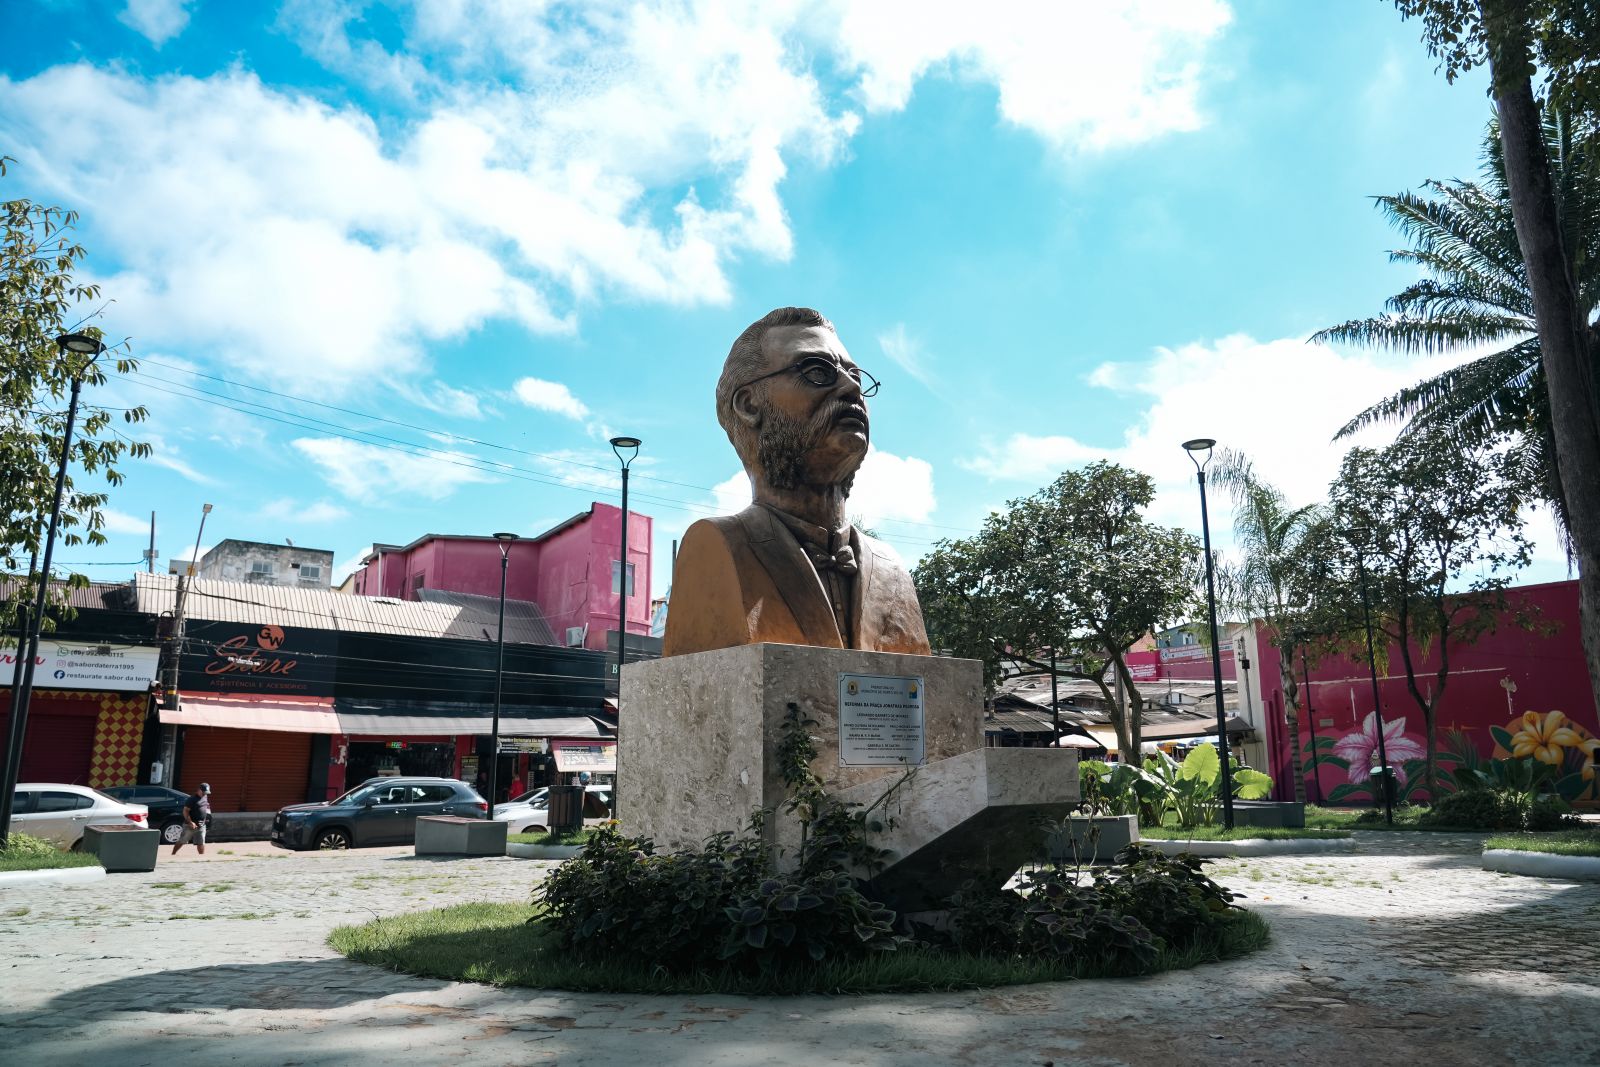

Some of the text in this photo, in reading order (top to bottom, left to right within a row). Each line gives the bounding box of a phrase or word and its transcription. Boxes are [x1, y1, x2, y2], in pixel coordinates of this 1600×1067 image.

[260, 627, 284, 647] GW
[205, 635, 297, 675] Store
[67, 661, 135, 670] @sabordaterra1995
